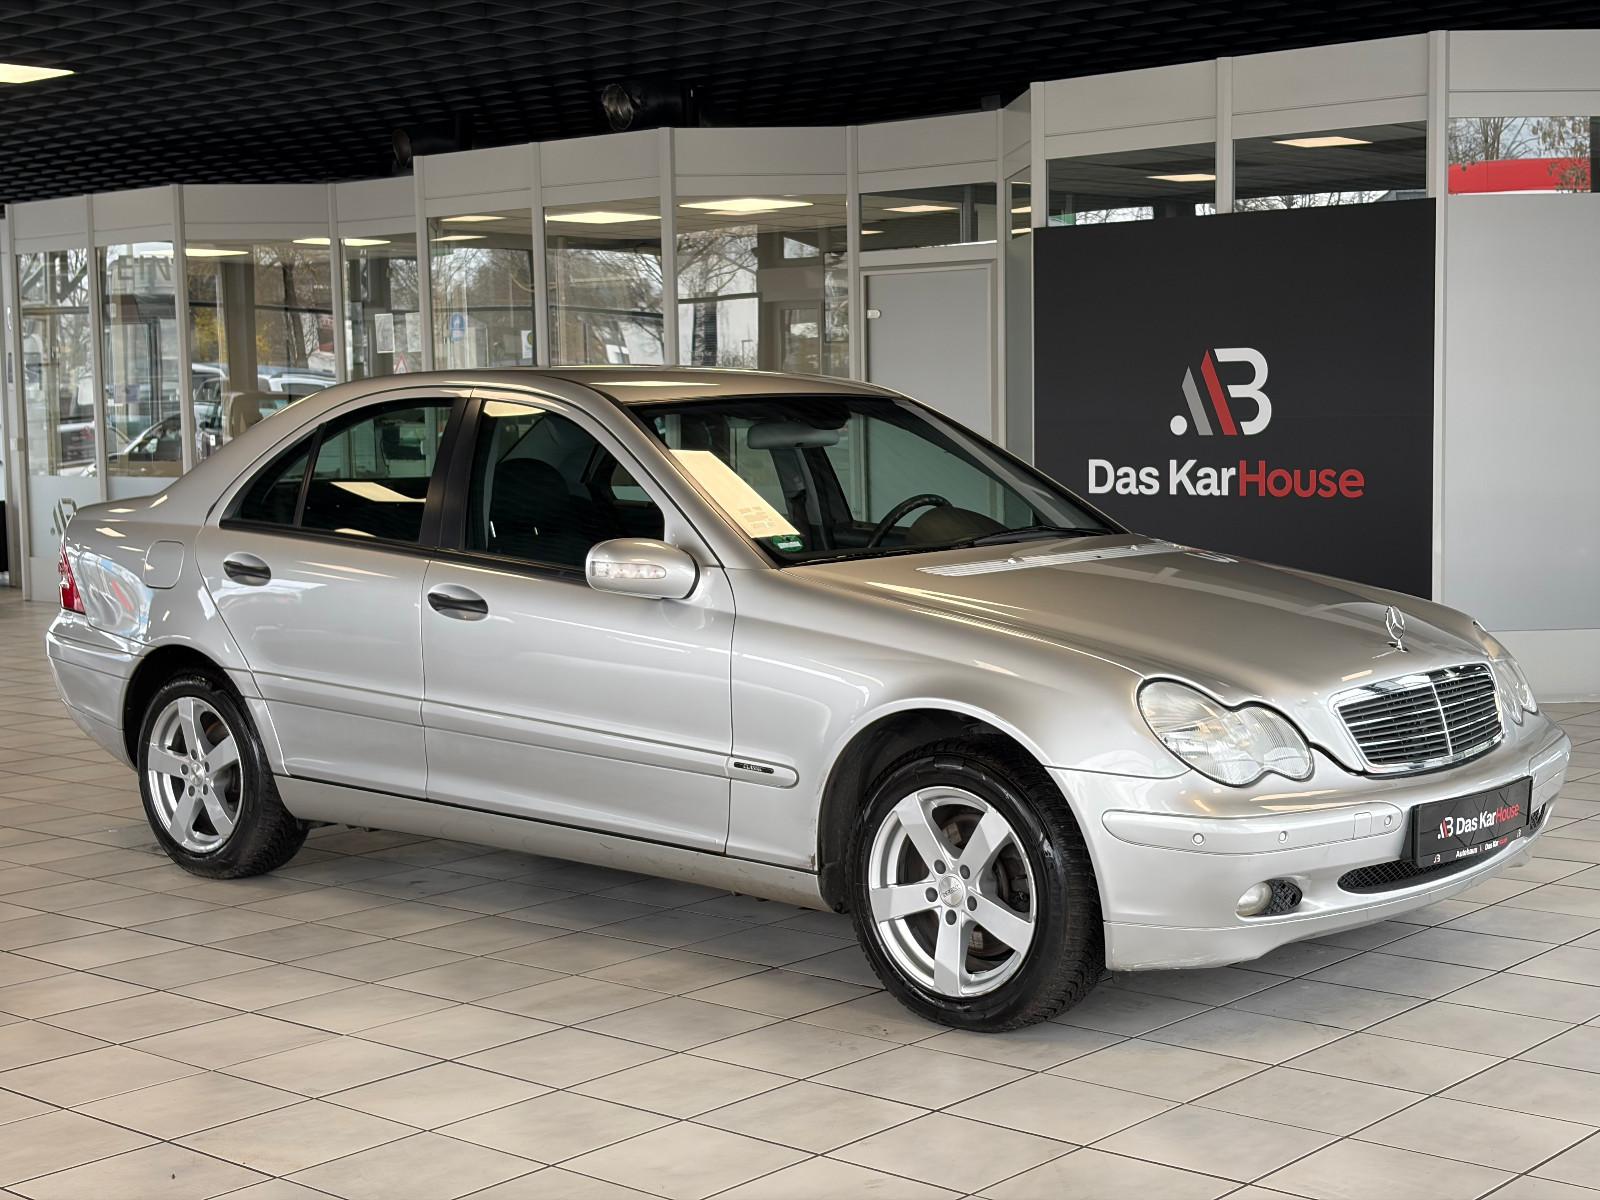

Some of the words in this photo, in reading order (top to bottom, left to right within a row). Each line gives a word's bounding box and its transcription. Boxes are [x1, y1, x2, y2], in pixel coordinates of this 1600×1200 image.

[1088, 459, 1160, 496] Das
[1169, 459, 1365, 498] KarHouse
[1456, 816, 1478, 834] Das
[1479, 803, 1520, 829] KarHouse
